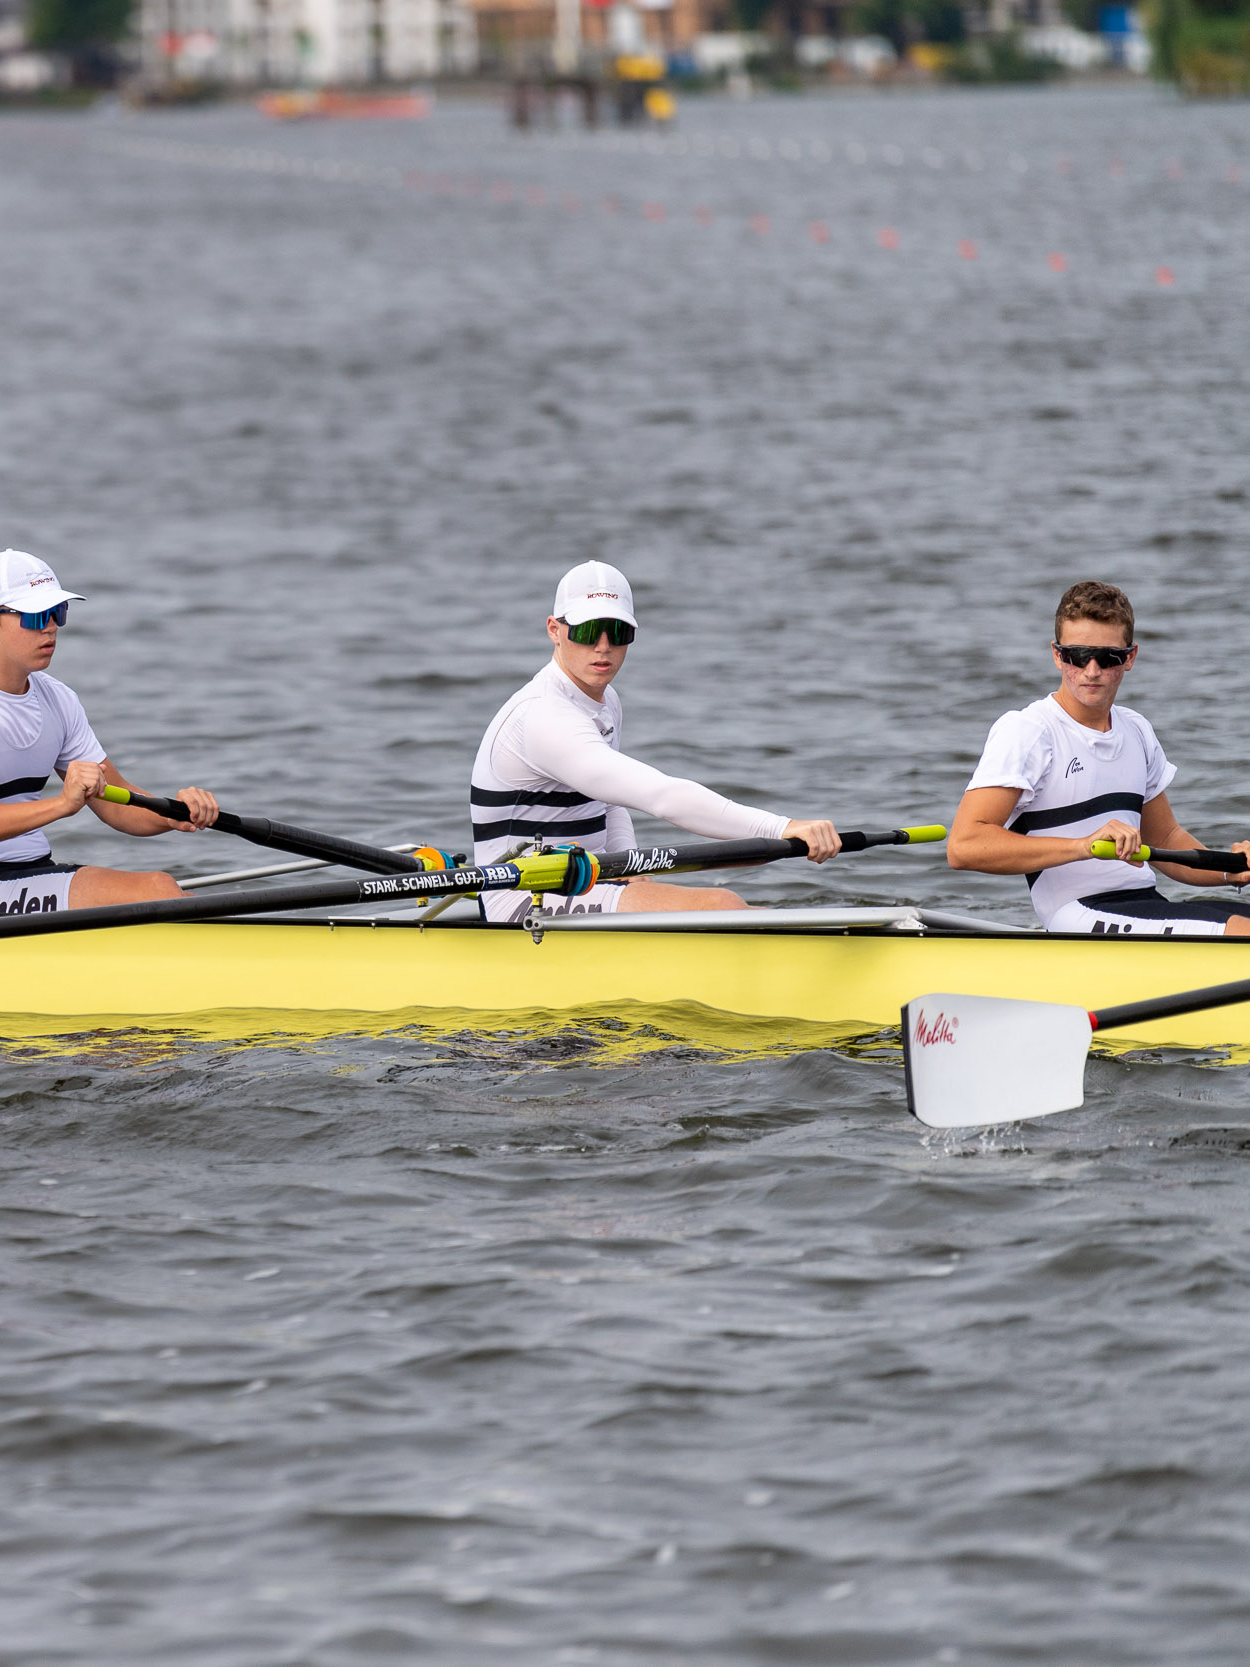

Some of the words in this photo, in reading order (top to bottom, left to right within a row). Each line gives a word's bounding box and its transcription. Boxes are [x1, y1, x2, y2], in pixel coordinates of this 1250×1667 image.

[587, 592, 619, 600] ROWING
[621, 847, 676, 875] Melitta
[485, 866, 517, 881] RBL
[362, 879, 402, 895] STARK.
[401, 874, 454, 892] SCHNELL.
[913, 1008, 958, 1048] Melitta
